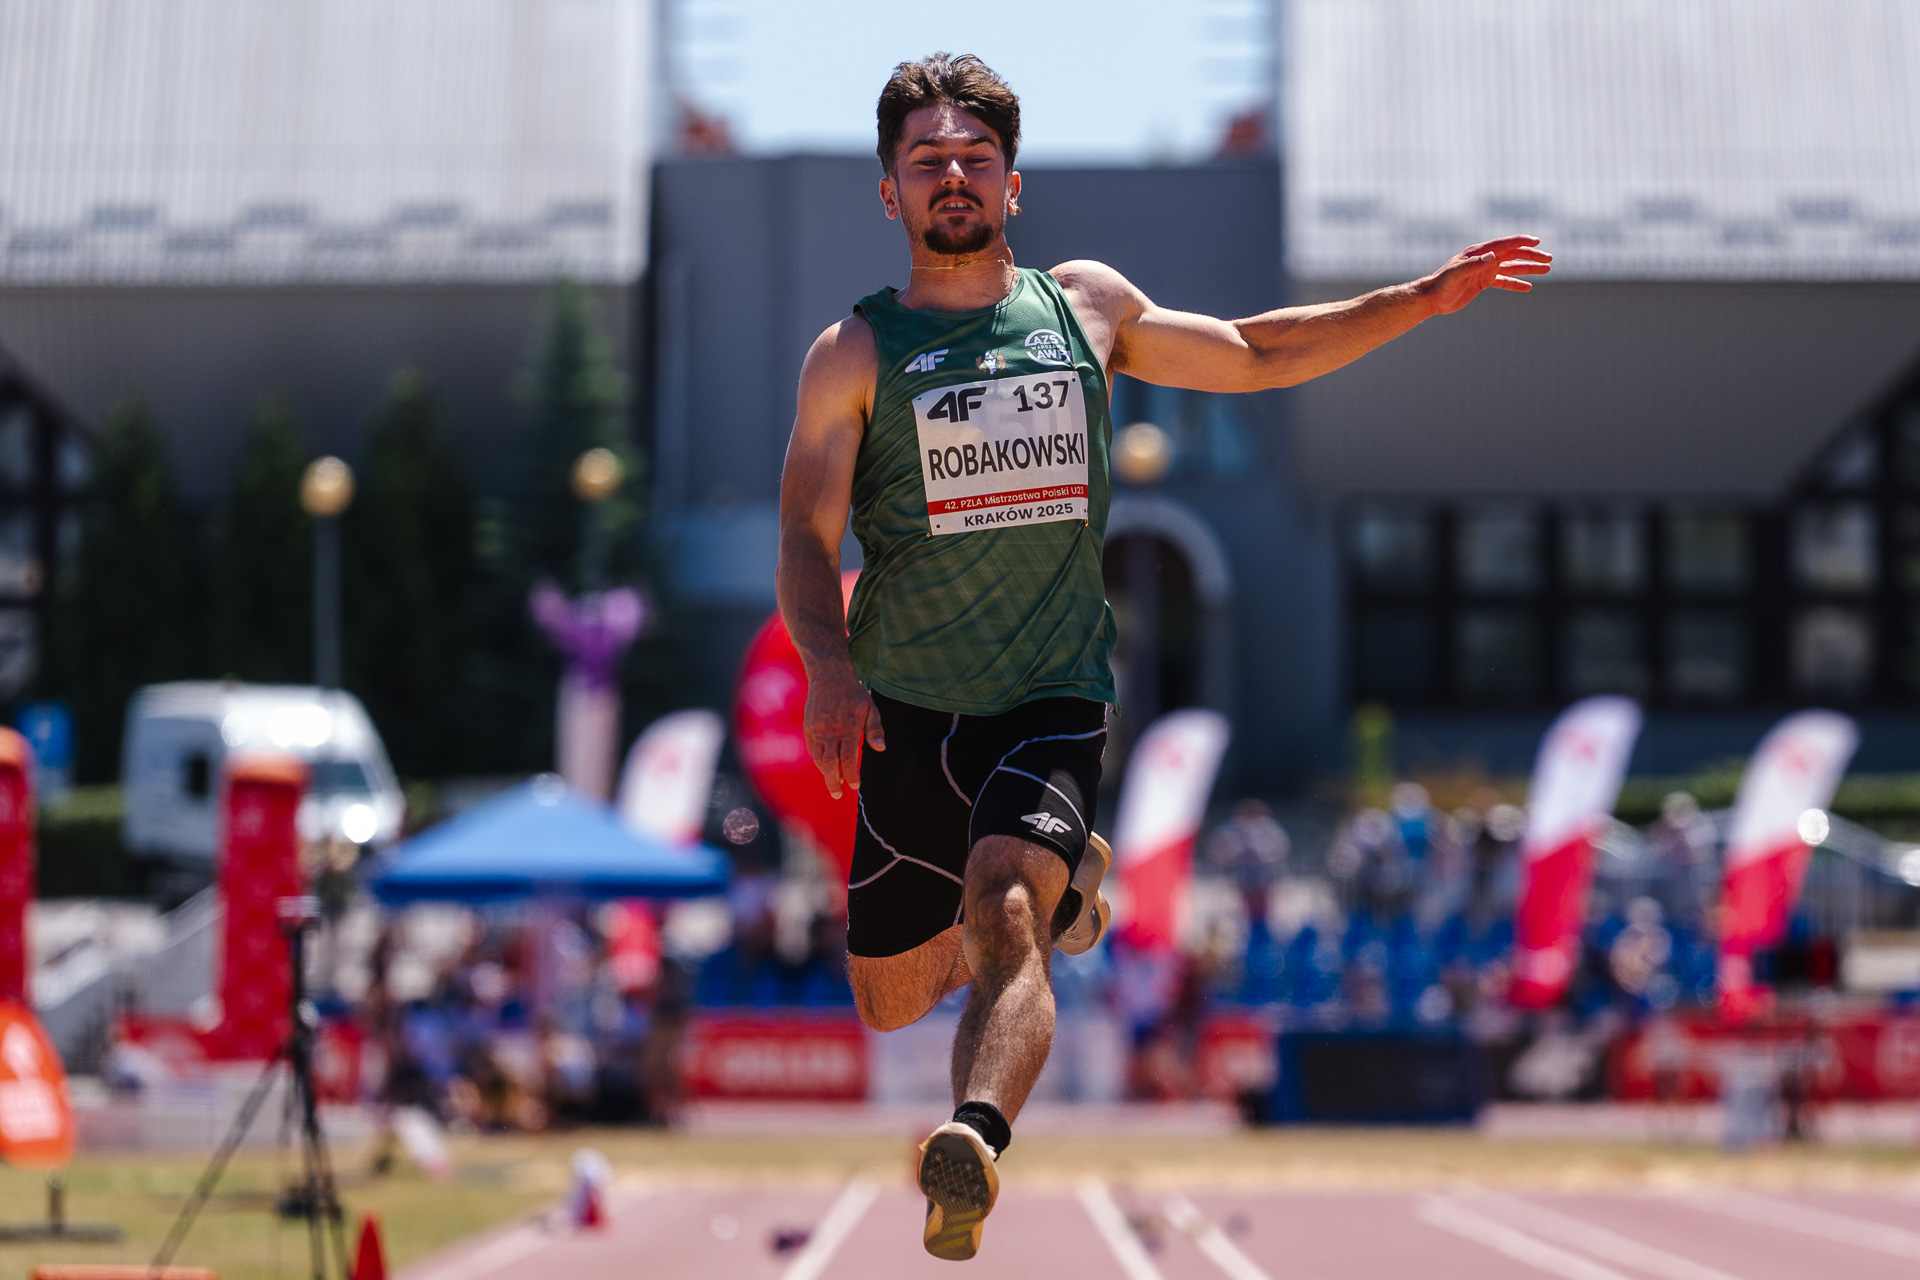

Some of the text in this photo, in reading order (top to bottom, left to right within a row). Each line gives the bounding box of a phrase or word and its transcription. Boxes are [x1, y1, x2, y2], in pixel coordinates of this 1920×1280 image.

[1034, 335, 1058, 344] AZS
[904, 348, 949, 373] 4F
[927, 386, 987, 423] 4F
[1012, 380, 1069, 412] 137
[927, 432, 1086, 481] ROBAKOWSKI
[944, 501, 959, 510] 42.
[960, 499, 983, 508] PZLA
[984, 492, 1041, 505] Mistrzostwa
[1042, 487, 1069, 499] Polski
[964, 503, 1074, 527] KRAKÓW 2025
[1020, 811, 1072, 834] 4F
